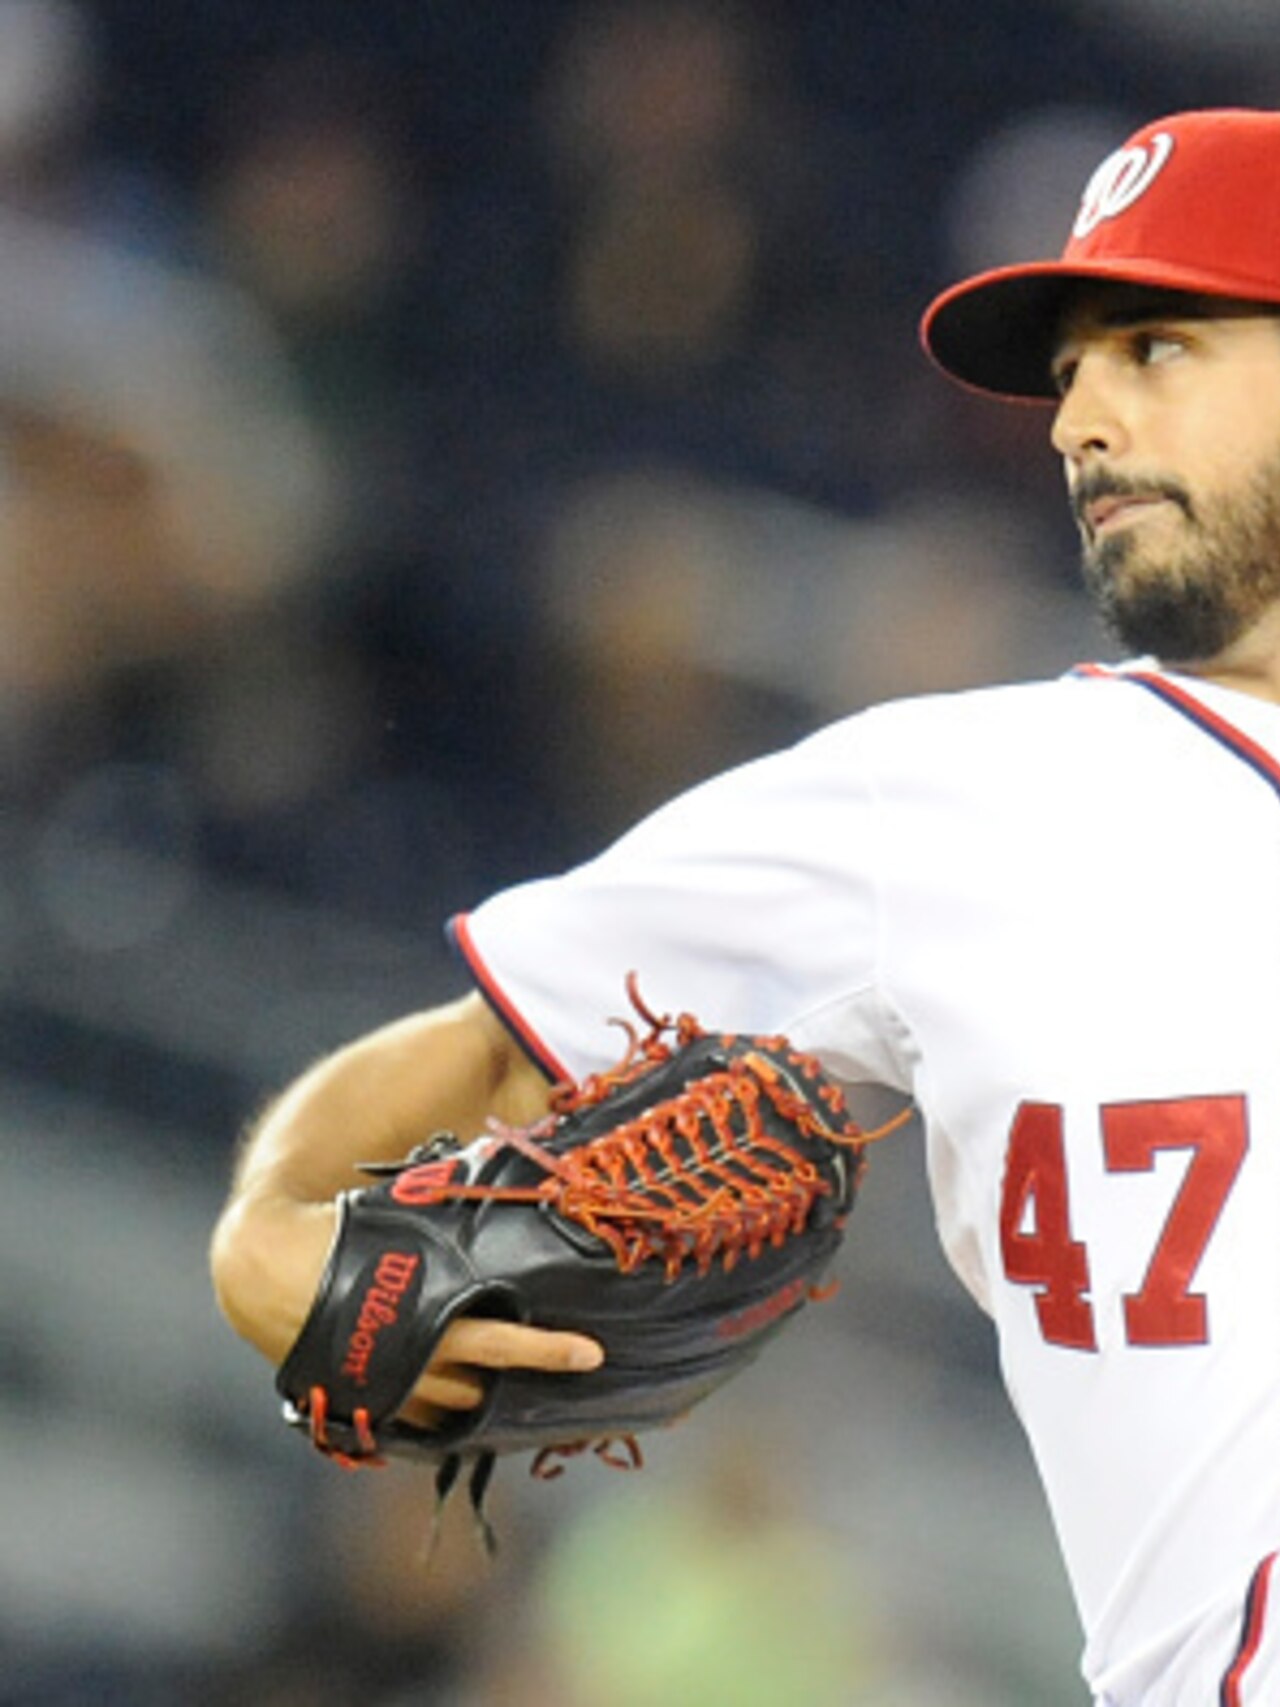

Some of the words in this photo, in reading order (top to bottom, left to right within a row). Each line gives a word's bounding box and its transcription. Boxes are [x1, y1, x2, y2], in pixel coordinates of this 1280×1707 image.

[1072, 132, 1174, 239] W
[999, 1092, 1250, 1353] 47
[342, 1251, 421, 1375] Wilson
